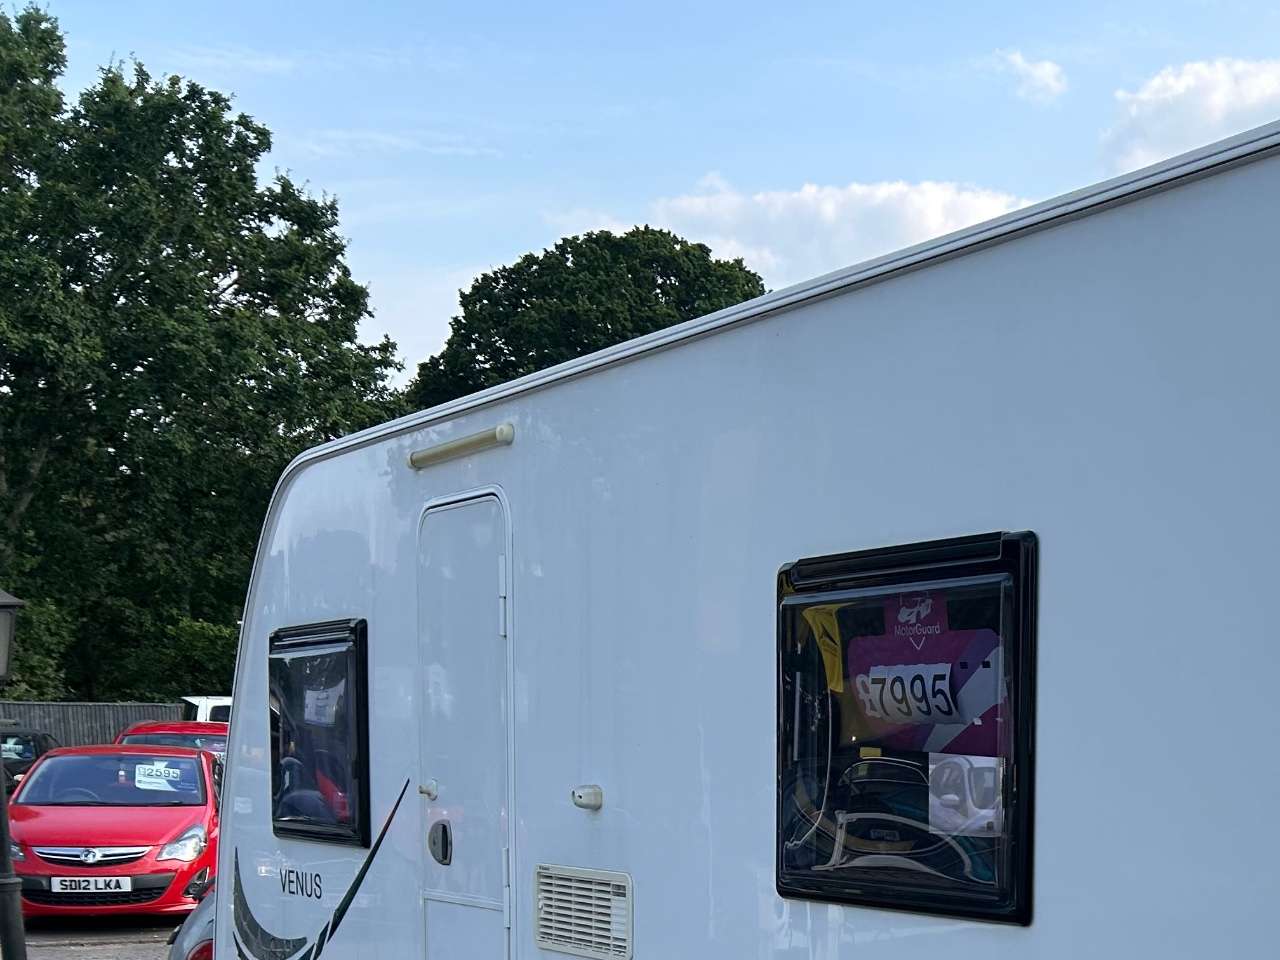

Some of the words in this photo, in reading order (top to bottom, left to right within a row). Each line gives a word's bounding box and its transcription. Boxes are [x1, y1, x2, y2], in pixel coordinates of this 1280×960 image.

[895, 623, 941, 637] MotorGuard
[60, 879, 91, 890] SD12
[95, 879, 122, 890] LKA
[280, 868, 322, 899] VENUS
